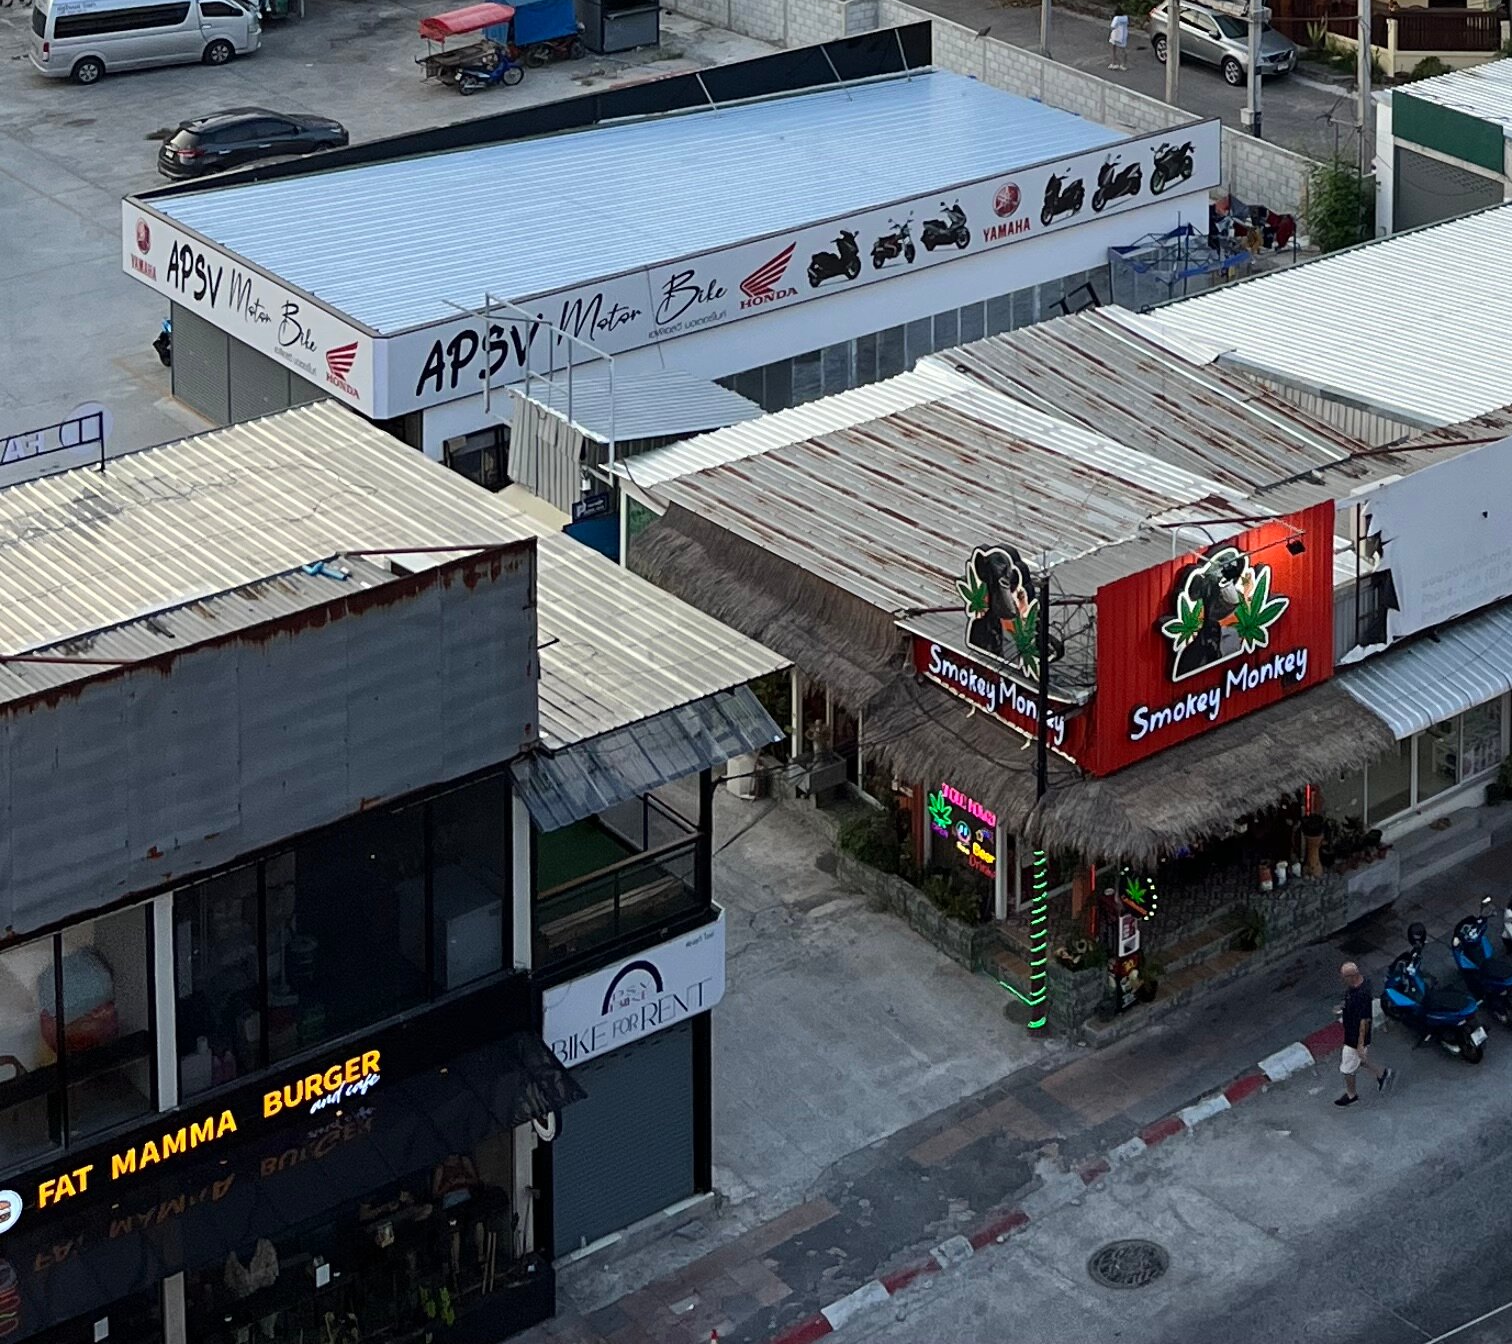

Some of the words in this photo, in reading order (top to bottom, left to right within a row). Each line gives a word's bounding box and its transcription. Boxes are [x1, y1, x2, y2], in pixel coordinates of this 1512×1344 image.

[130, 253, 157, 282] YAMAHA
[983, 216, 1031, 243] YAMAHA
[166, 240, 223, 309] APSV
[277, 299, 318, 353] Bike
[415, 313, 544, 397] APSV
[556, 292, 643, 346] Motor
[655, 268, 729, 326] Bike
[739, 286, 799, 310] HONDA
[325, 372, 361, 401] HONDA
[928, 643, 996, 713] Smokey
[999, 676, 1065, 746] Money
[1130, 686, 1221, 741] Smokey
[1225, 648, 1308, 699] Monkey
[551, 1020, 609, 1063] BIKE
[612, 1013, 639, 1039] FOR
[641, 977, 713, 1032] RENT
[38, 1164, 94, 1210] FAT
[110, 1109, 239, 1180] MAMMA
[263, 1049, 381, 1119] BURGER
[309, 1080, 342, 1114] and
